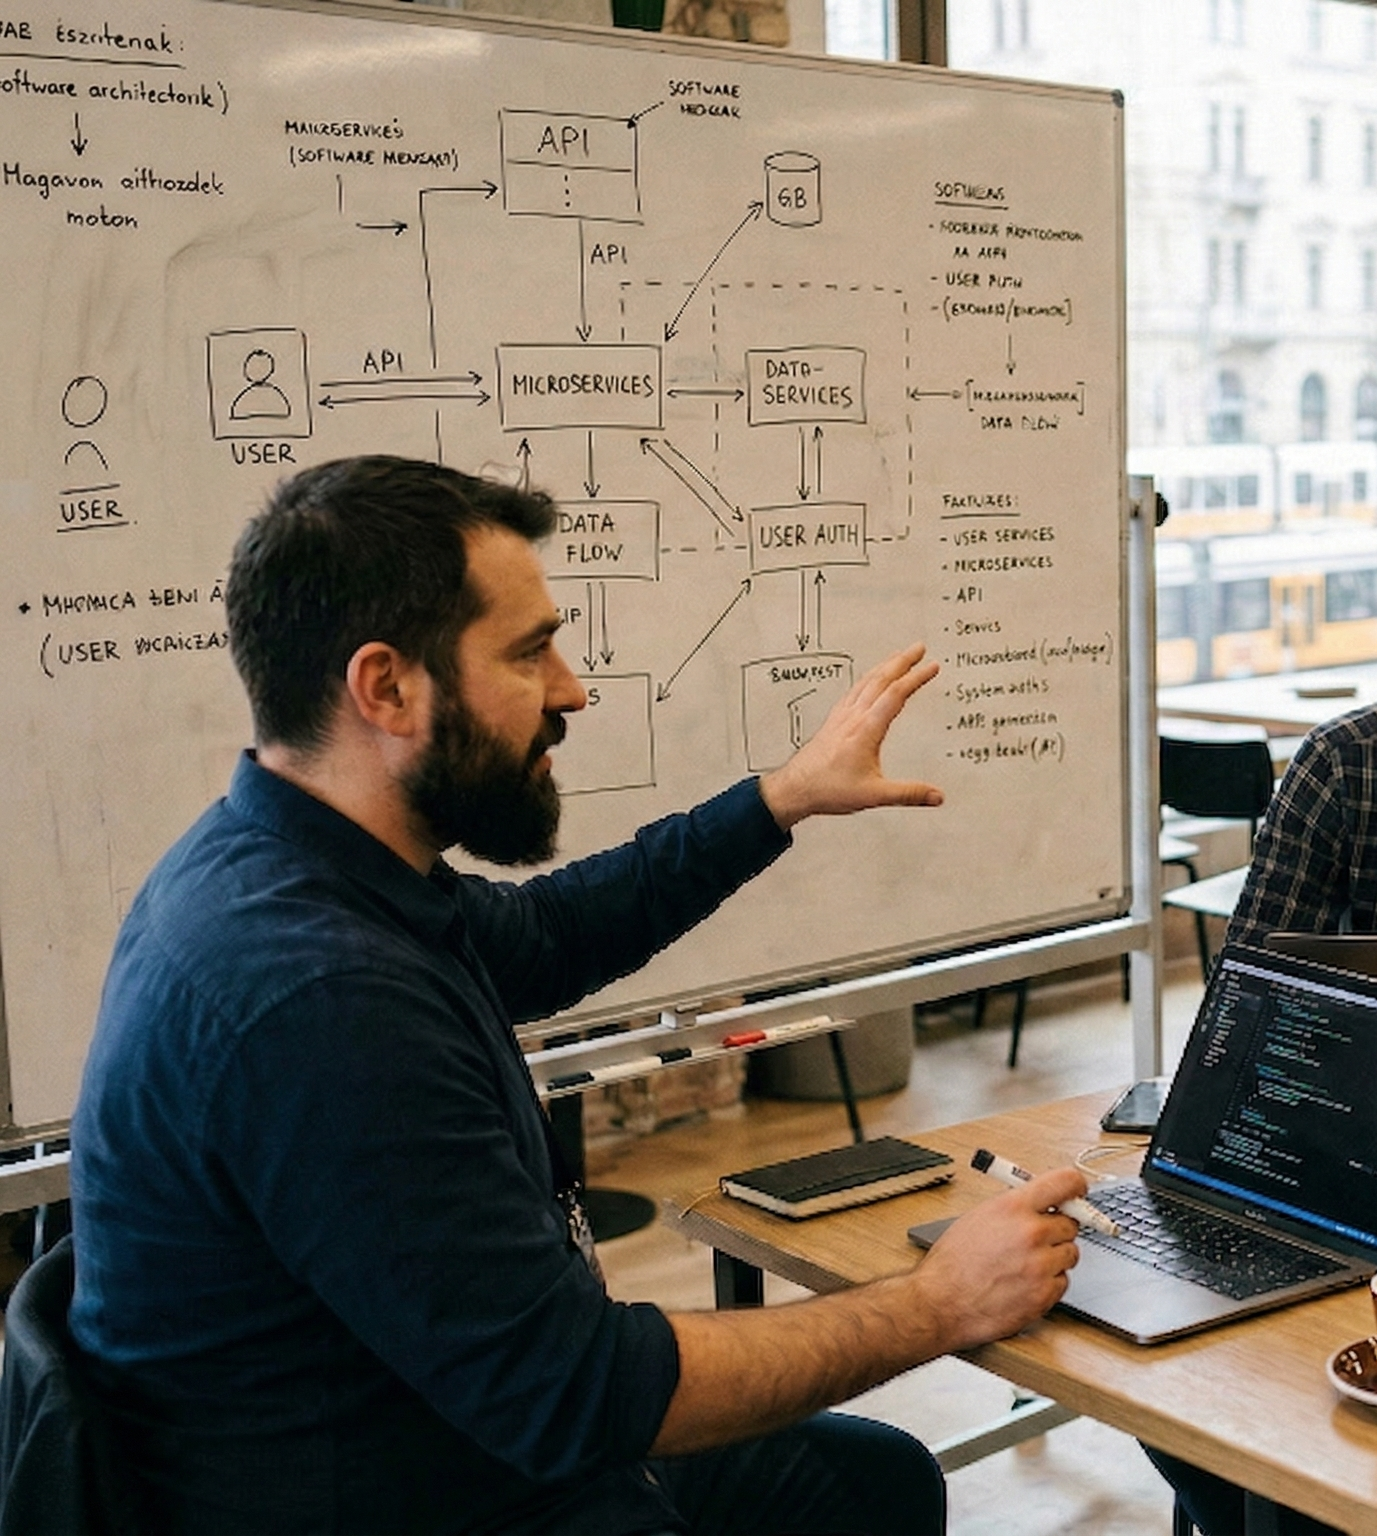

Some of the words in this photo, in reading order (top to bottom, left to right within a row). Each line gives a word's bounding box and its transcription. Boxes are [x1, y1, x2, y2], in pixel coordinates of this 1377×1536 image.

[669, 79, 740, 99] SOFTWARE
[537, 125, 590, 158] API
[591, 243, 628, 265] API
[946, 271, 980, 287] USER
[364, 351, 402, 373] API
[512, 373, 655, 398] MICROSERVICES
[762, 384, 854, 409] SERVICES
[231, 443, 297, 465] USER
[60, 500, 124, 523] USER
[558, 512, 616, 534] DATA
[759, 524, 807, 549] USER
[814, 523, 859, 548] AUTH
[953, 530, 988, 547] USER
[995, 526, 1056, 544] SERVICES
[566, 543, 624, 563] FLOW
[956, 586, 983, 604] API
